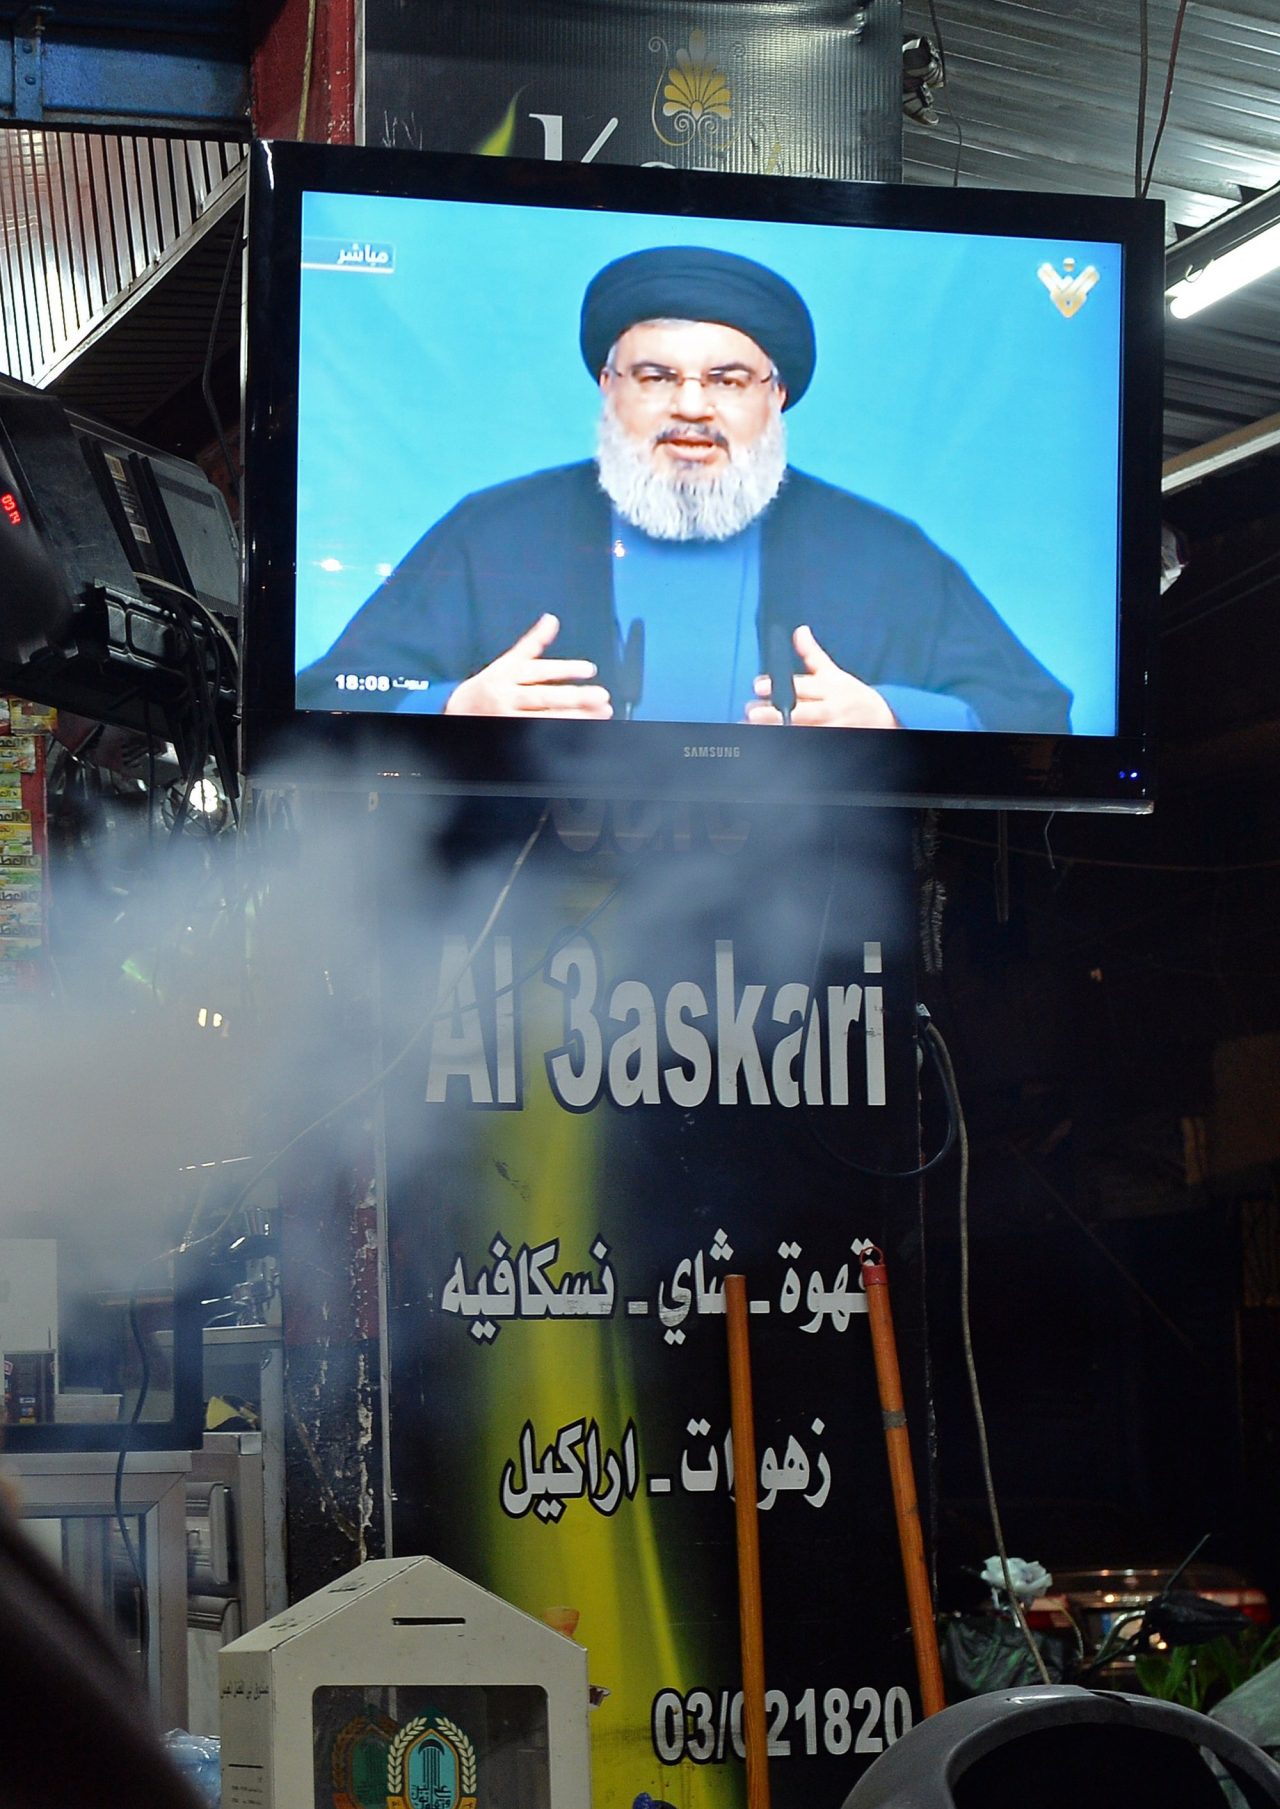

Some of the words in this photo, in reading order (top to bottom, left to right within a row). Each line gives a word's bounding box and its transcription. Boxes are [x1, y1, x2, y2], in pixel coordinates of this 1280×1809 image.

[337, 243, 389, 266] مباشر
[683, 746, 741, 758] SAMSUNG
[425, 935, 517, 1104] Al
[549, 939, 886, 1108] 3askari
[441, 1240, 615, 1339] نسكافيه
[658, 1228, 734, 1345] شاي
[503, 1423, 637, 1518] اراكيل
[681, 1417, 831, 1511] زهوات
